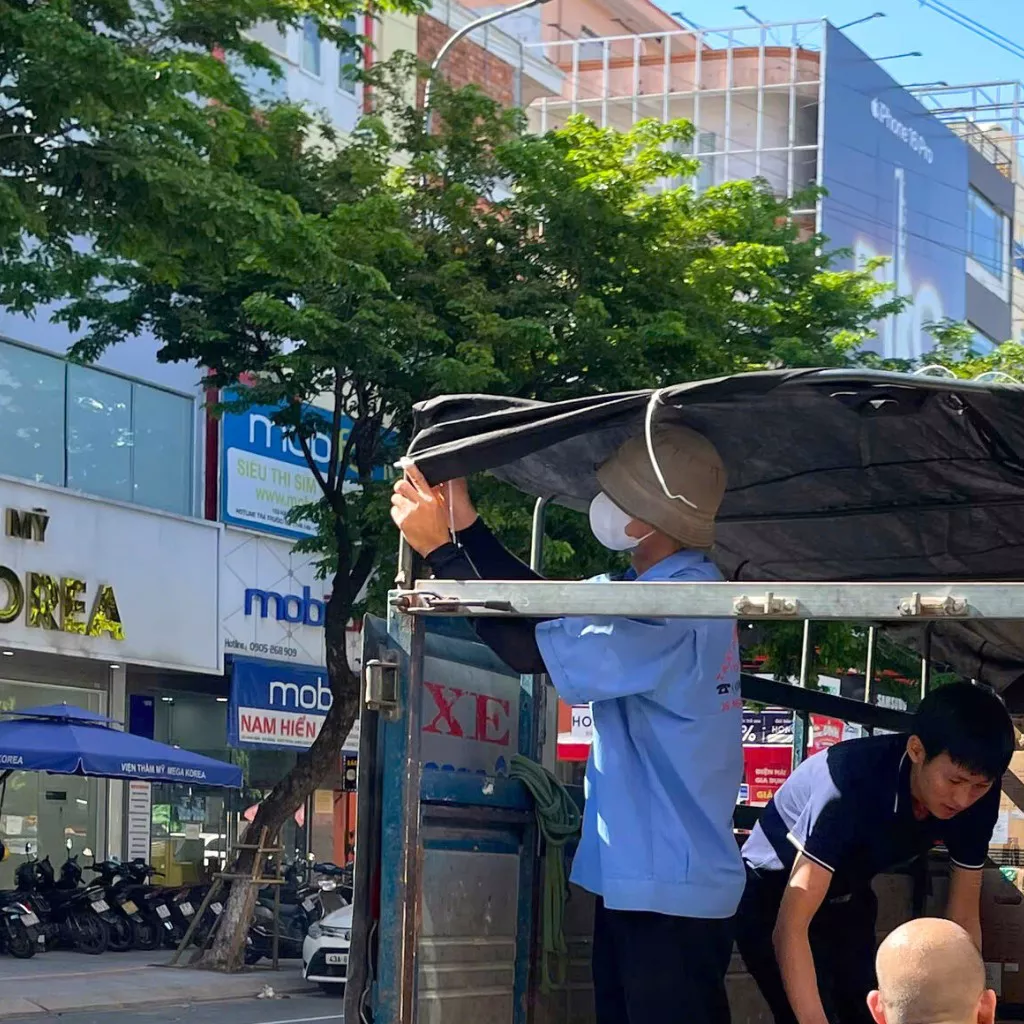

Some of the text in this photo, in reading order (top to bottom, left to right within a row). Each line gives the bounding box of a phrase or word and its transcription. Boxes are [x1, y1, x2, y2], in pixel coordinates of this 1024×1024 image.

[5, 507, 50, 542] MỸ
[244, 586, 328, 627] mob
[269, 677, 335, 711] mob
[241, 715, 276, 735] NAM
[421, 680, 509, 746] XE
[167, 766, 184, 777] MEGA
[185, 768, 206, 779] KOREA
